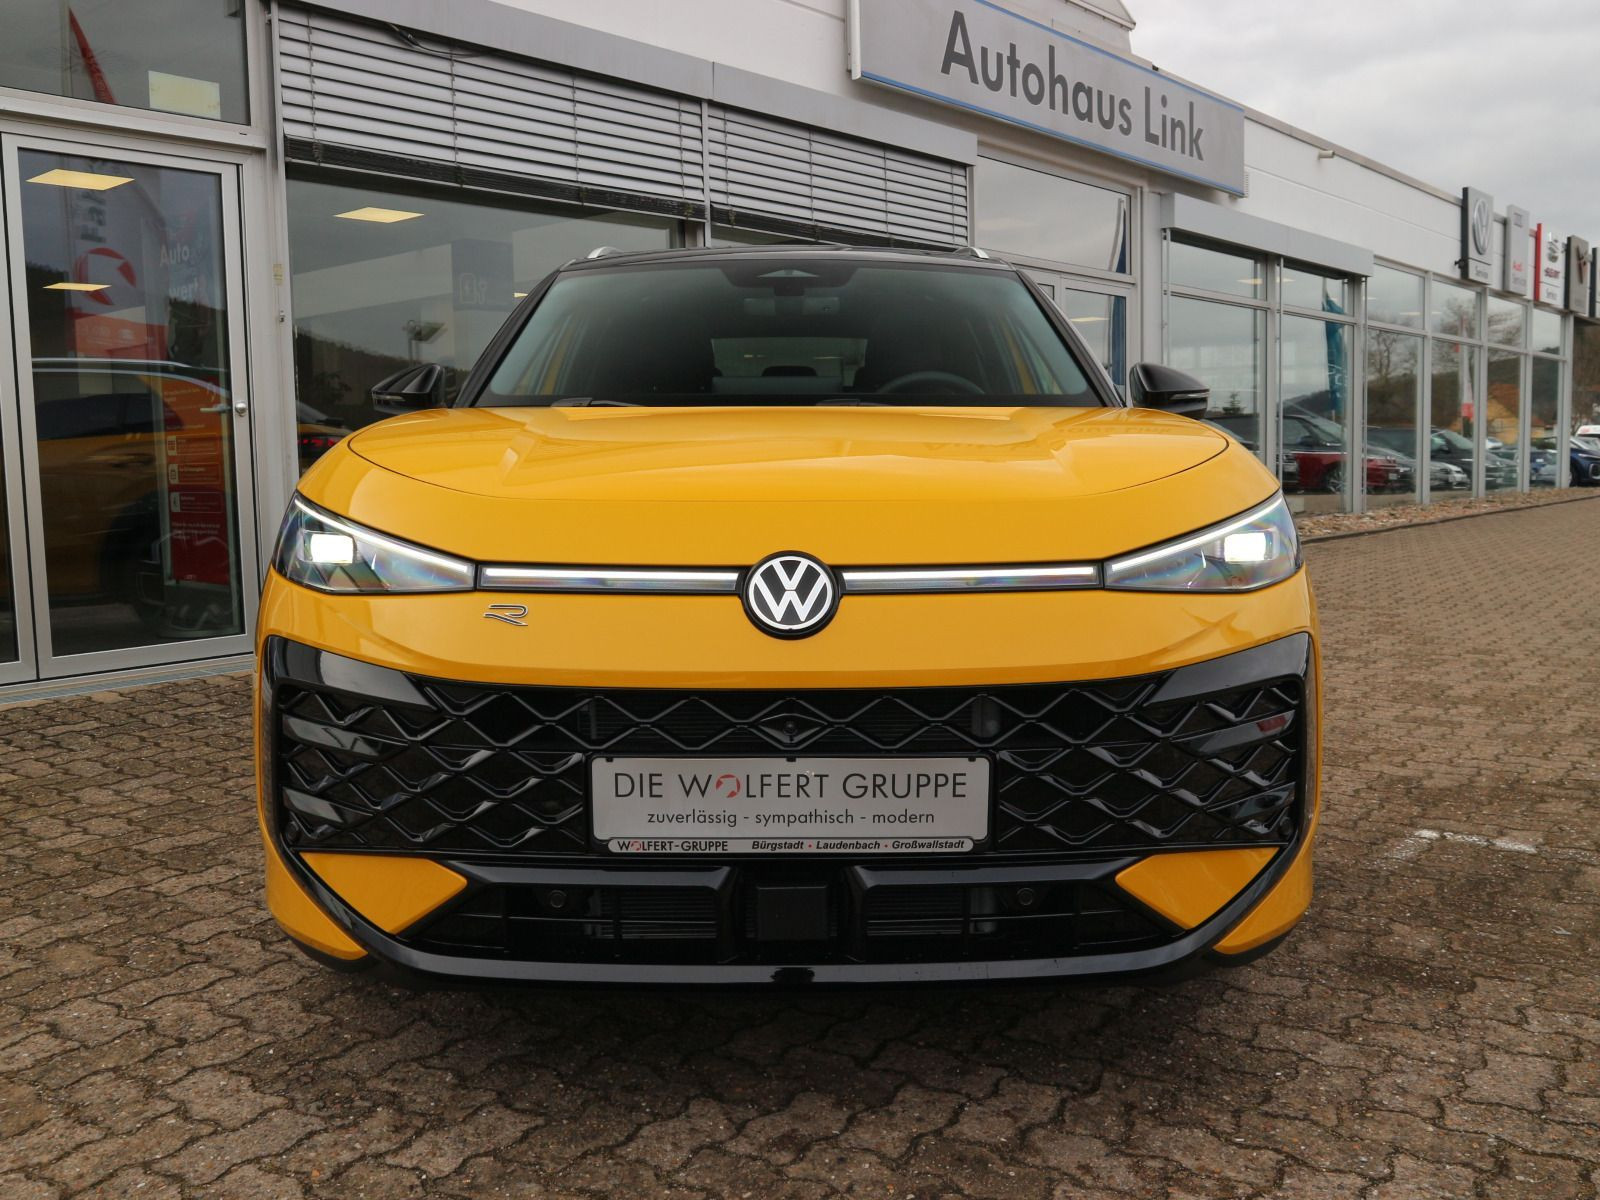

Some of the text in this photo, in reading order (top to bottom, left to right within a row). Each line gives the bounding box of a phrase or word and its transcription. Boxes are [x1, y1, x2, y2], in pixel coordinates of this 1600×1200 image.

[941, 10, 1204, 161] Autohaus Link
[483, 604, 529, 627] R
[614, 772, 967, 799] DIE WOLFERT GRUPPE
[647, 808, 737, 828] zuverlässig
[755, 808, 854, 827] sympathisch
[872, 808, 935, 824] modern
[617, 839, 965, 852] WOLFERT-GRUPPE Bürgstadt Laudenbach Großwallstadt
